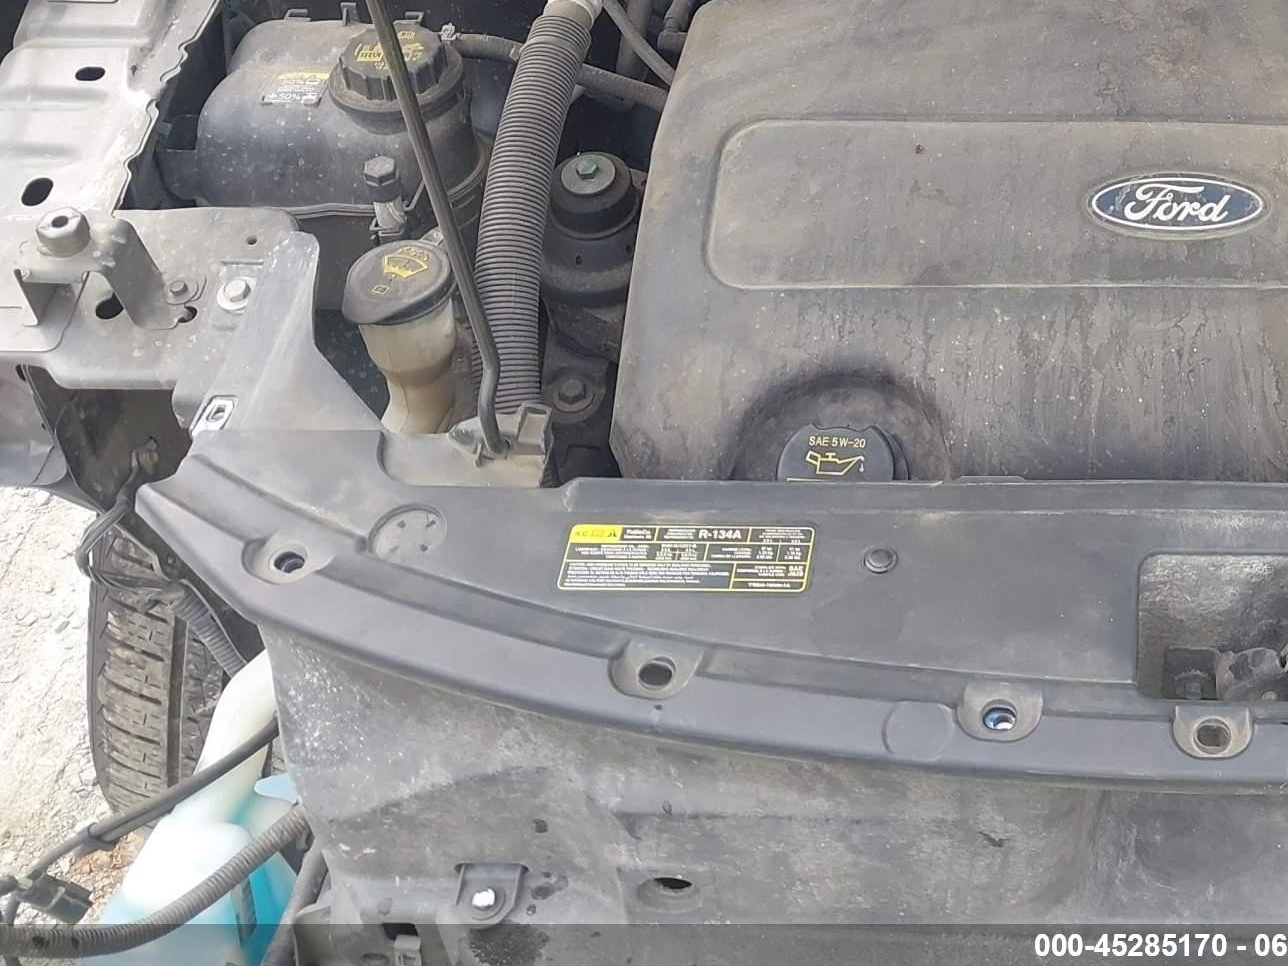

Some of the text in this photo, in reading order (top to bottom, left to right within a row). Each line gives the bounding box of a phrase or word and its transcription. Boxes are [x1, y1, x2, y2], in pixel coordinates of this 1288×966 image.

[1124, 183, 1232, 222] Ford
[809, 436, 866, 448] SAE 5W-20
[698, 529, 742, 539] R-134A
